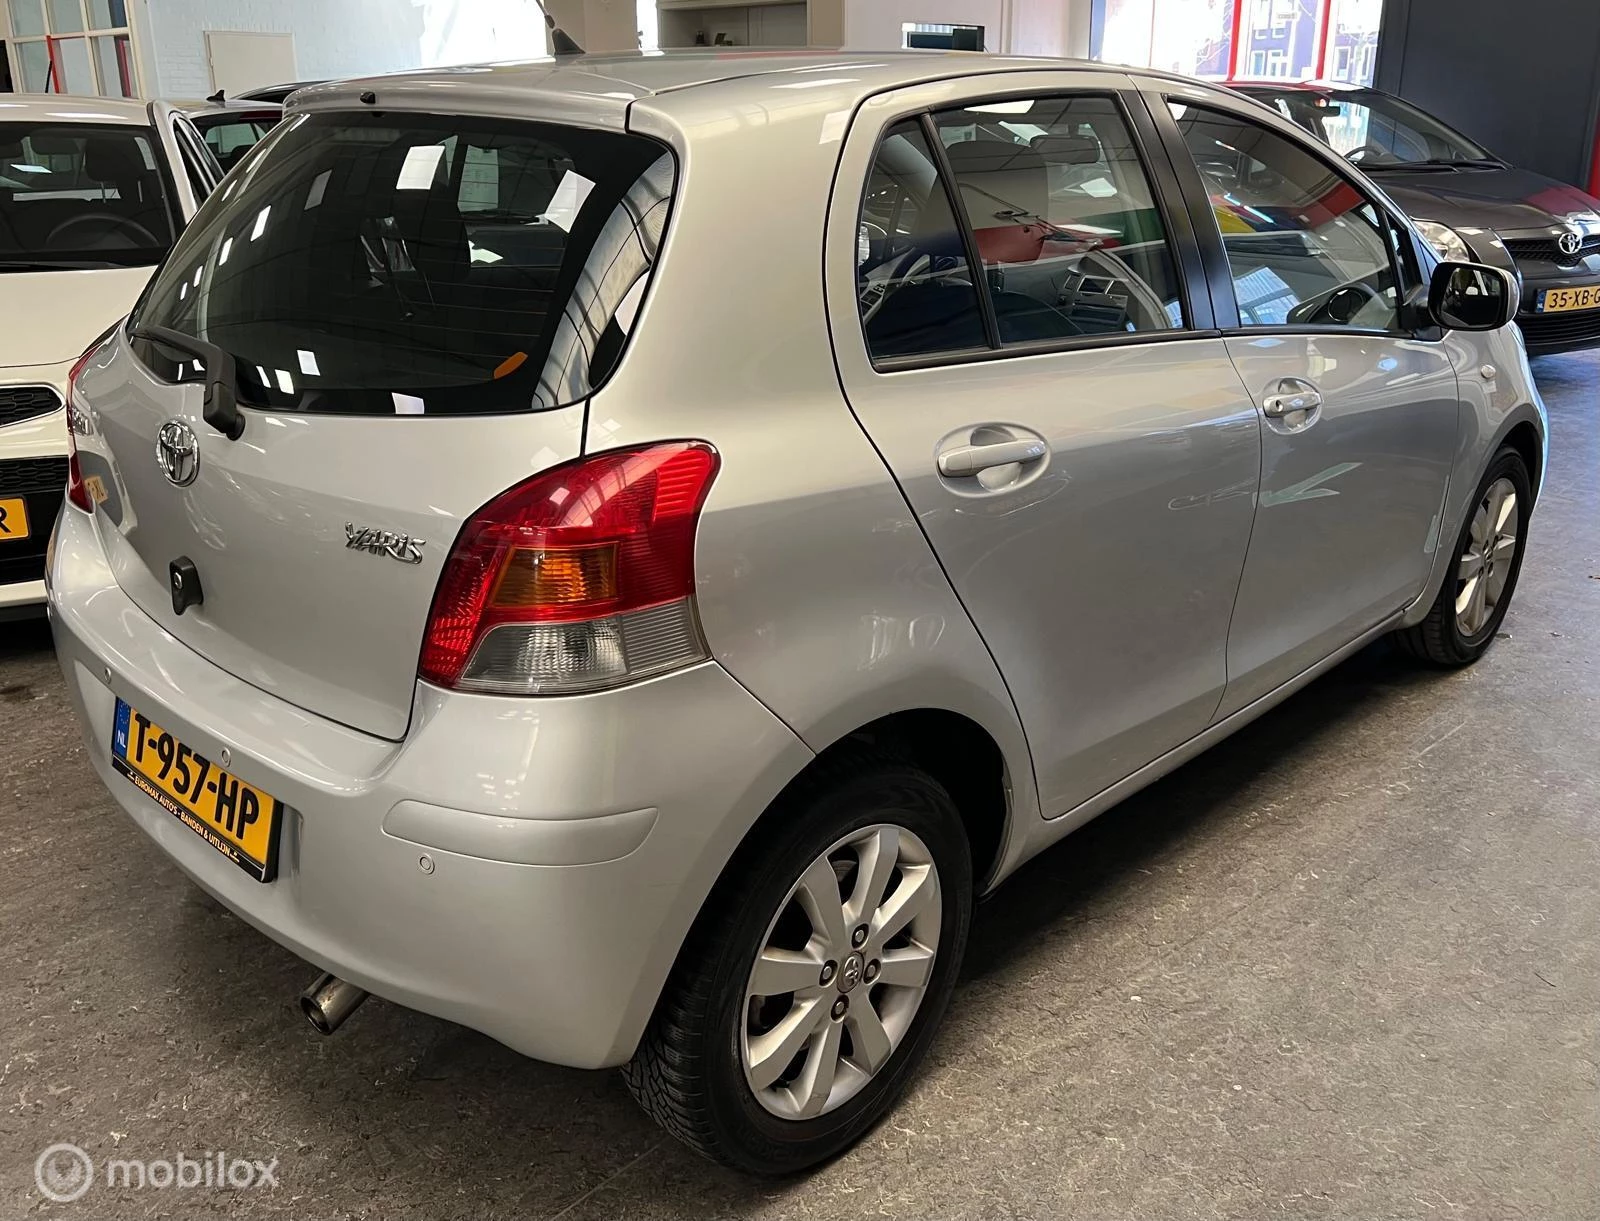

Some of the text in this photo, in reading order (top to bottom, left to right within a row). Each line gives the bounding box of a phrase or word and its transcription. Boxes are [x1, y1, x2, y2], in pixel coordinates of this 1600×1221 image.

[344, 521, 426, 564] YARIS
[117, 729, 127, 748] NL
[134, 713, 260, 840] T-957-HP
[134, 775, 160, 801] EUROMAX
[180, 811, 204, 836] BANDEN
